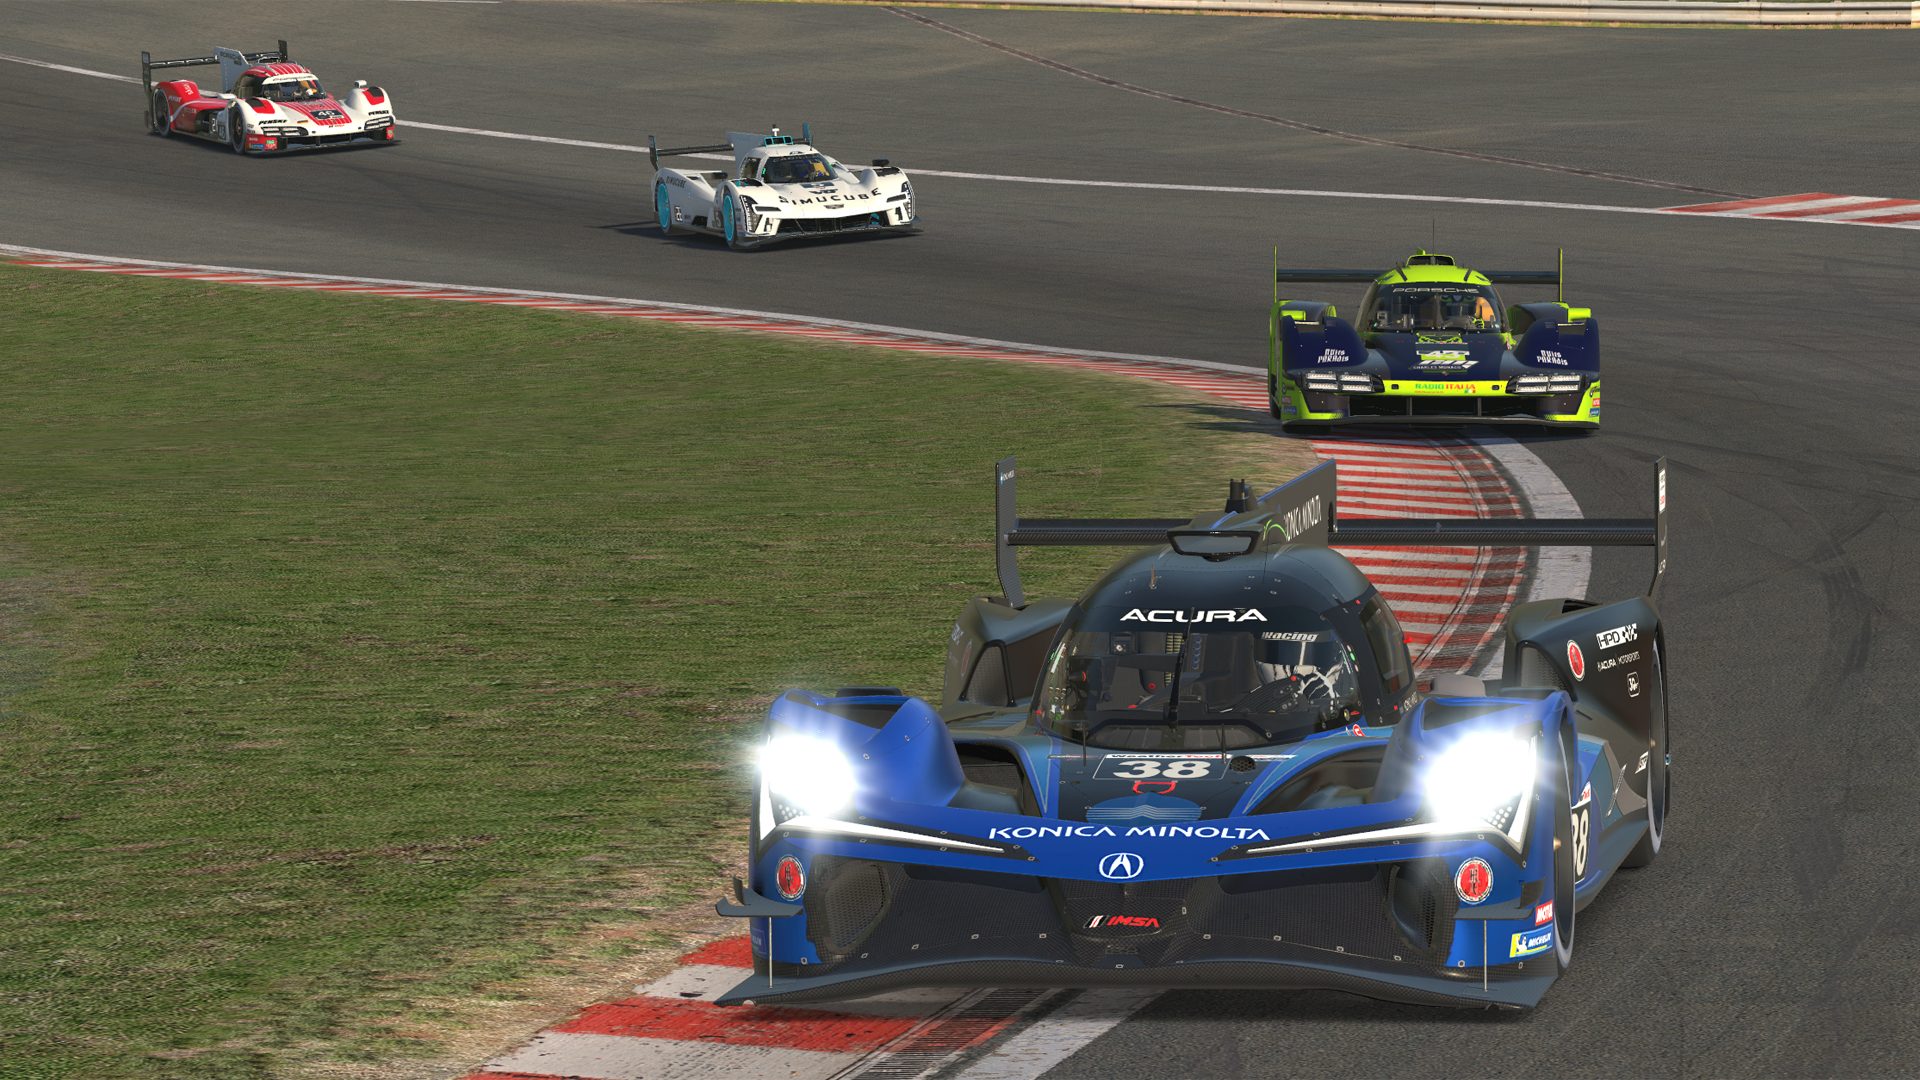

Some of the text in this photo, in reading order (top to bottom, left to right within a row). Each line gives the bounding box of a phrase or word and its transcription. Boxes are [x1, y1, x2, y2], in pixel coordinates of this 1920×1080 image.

[779, 188, 881, 205] SIMUCUBE
[1120, 608, 1268, 623] ACURA
[1597, 630, 1620, 648] HPD
[1113, 760, 1211, 779] 38
[989, 826, 1270, 840] KONICA MINOLTA
[1106, 915, 1160, 928] IMSA
